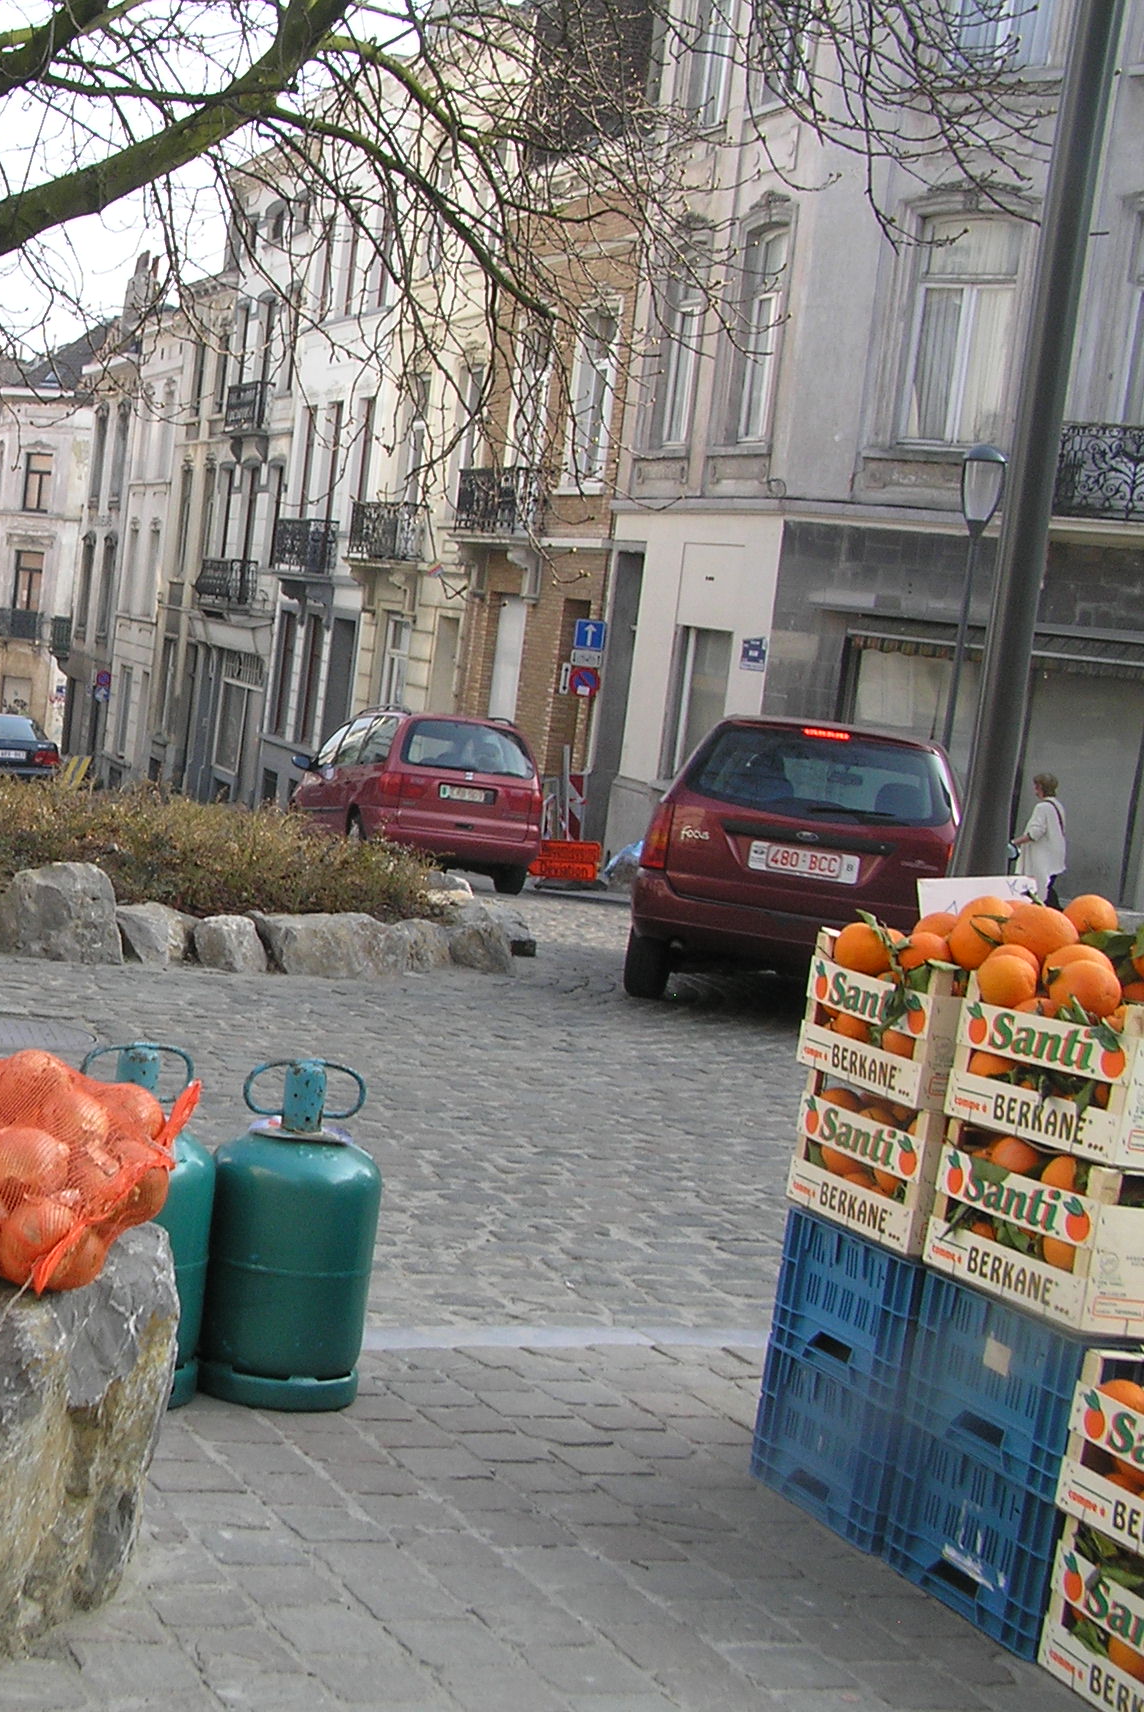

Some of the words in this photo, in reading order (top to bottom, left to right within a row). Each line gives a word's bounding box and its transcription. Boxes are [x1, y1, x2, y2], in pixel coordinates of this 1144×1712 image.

[771, 849, 799, 868] 480
[809, 854, 838, 873] BCC
[829, 971, 899, 1024] Sant
[832, 1044, 897, 1092] BERKANE
[988, 1012, 1095, 1071] Santi
[819, 1107, 897, 1167] Santi
[993, 1093, 1086, 1145] BERKANE
[819, 1181, 888, 1234] BERKANE
[963, 1167, 1061, 1231] Santi
[967, 1246, 1054, 1306] BERKANE
